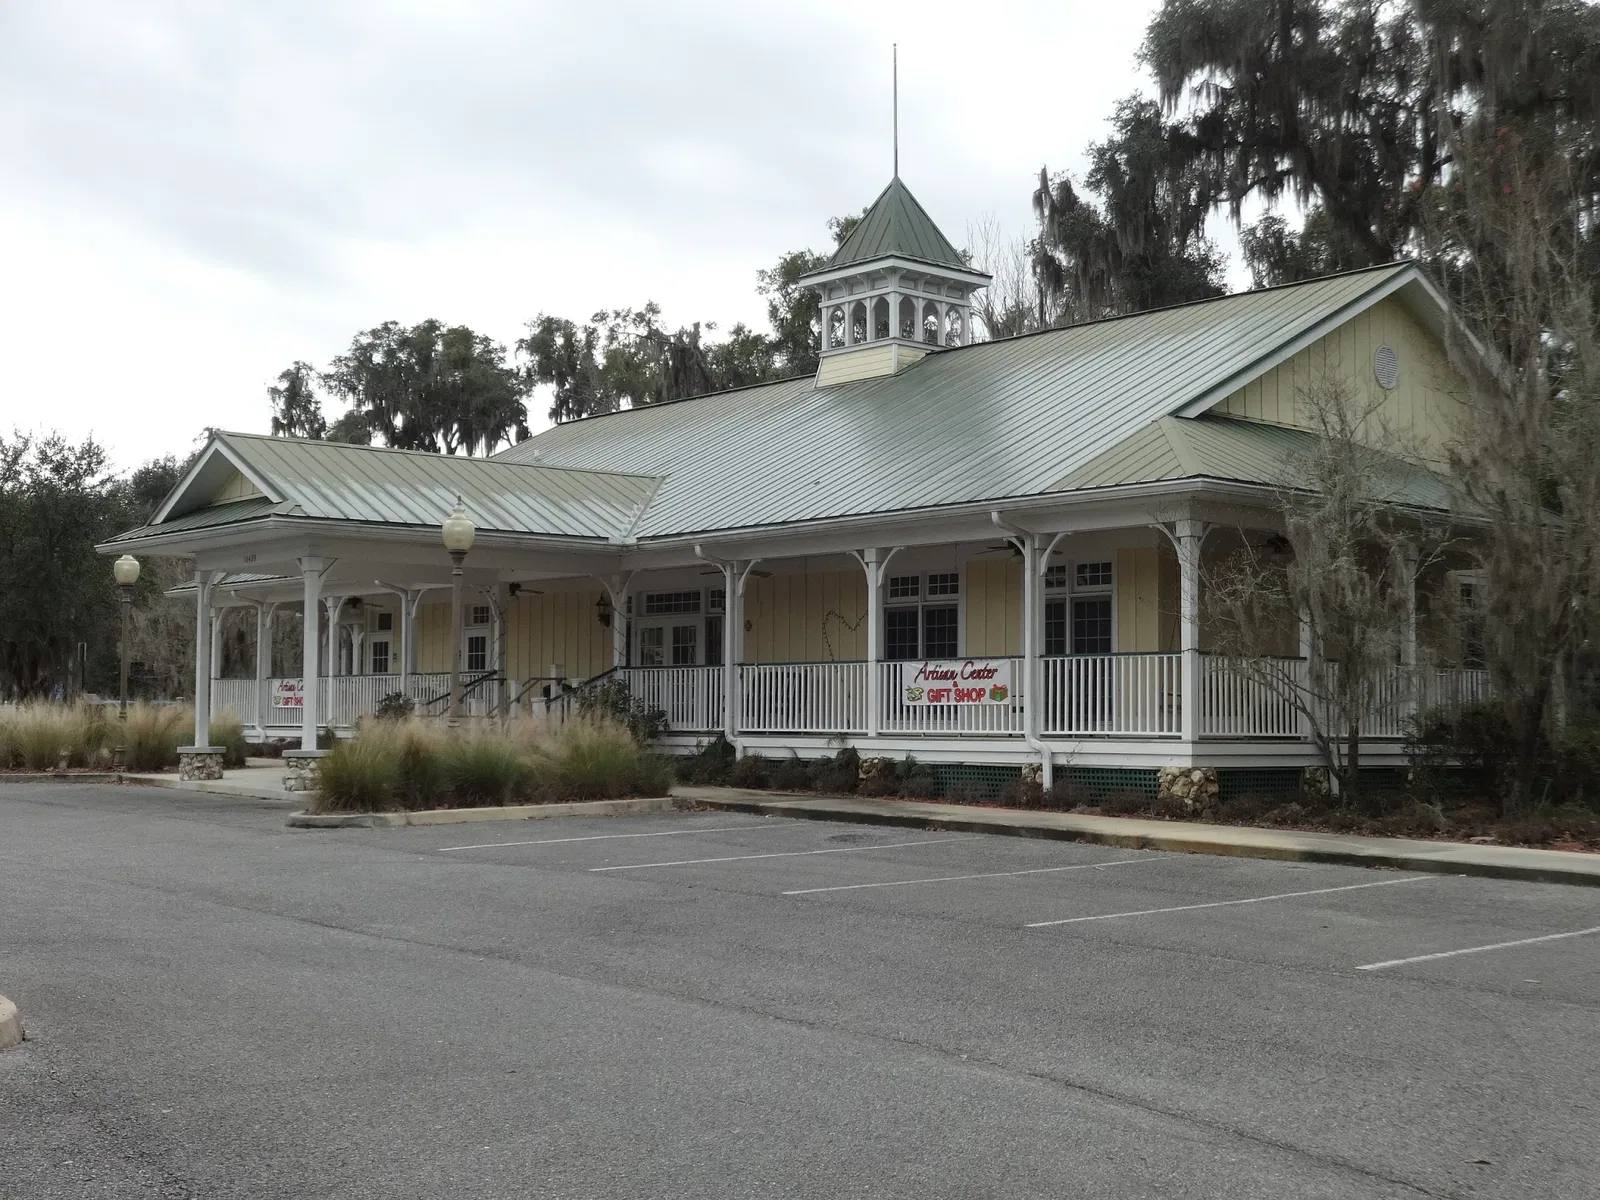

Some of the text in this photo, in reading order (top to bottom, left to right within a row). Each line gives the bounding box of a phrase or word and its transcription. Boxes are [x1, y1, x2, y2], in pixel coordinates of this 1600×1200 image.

[914, 660, 998, 683] Artisan Center
[927, 687, 986, 703] GIFT SHOP
